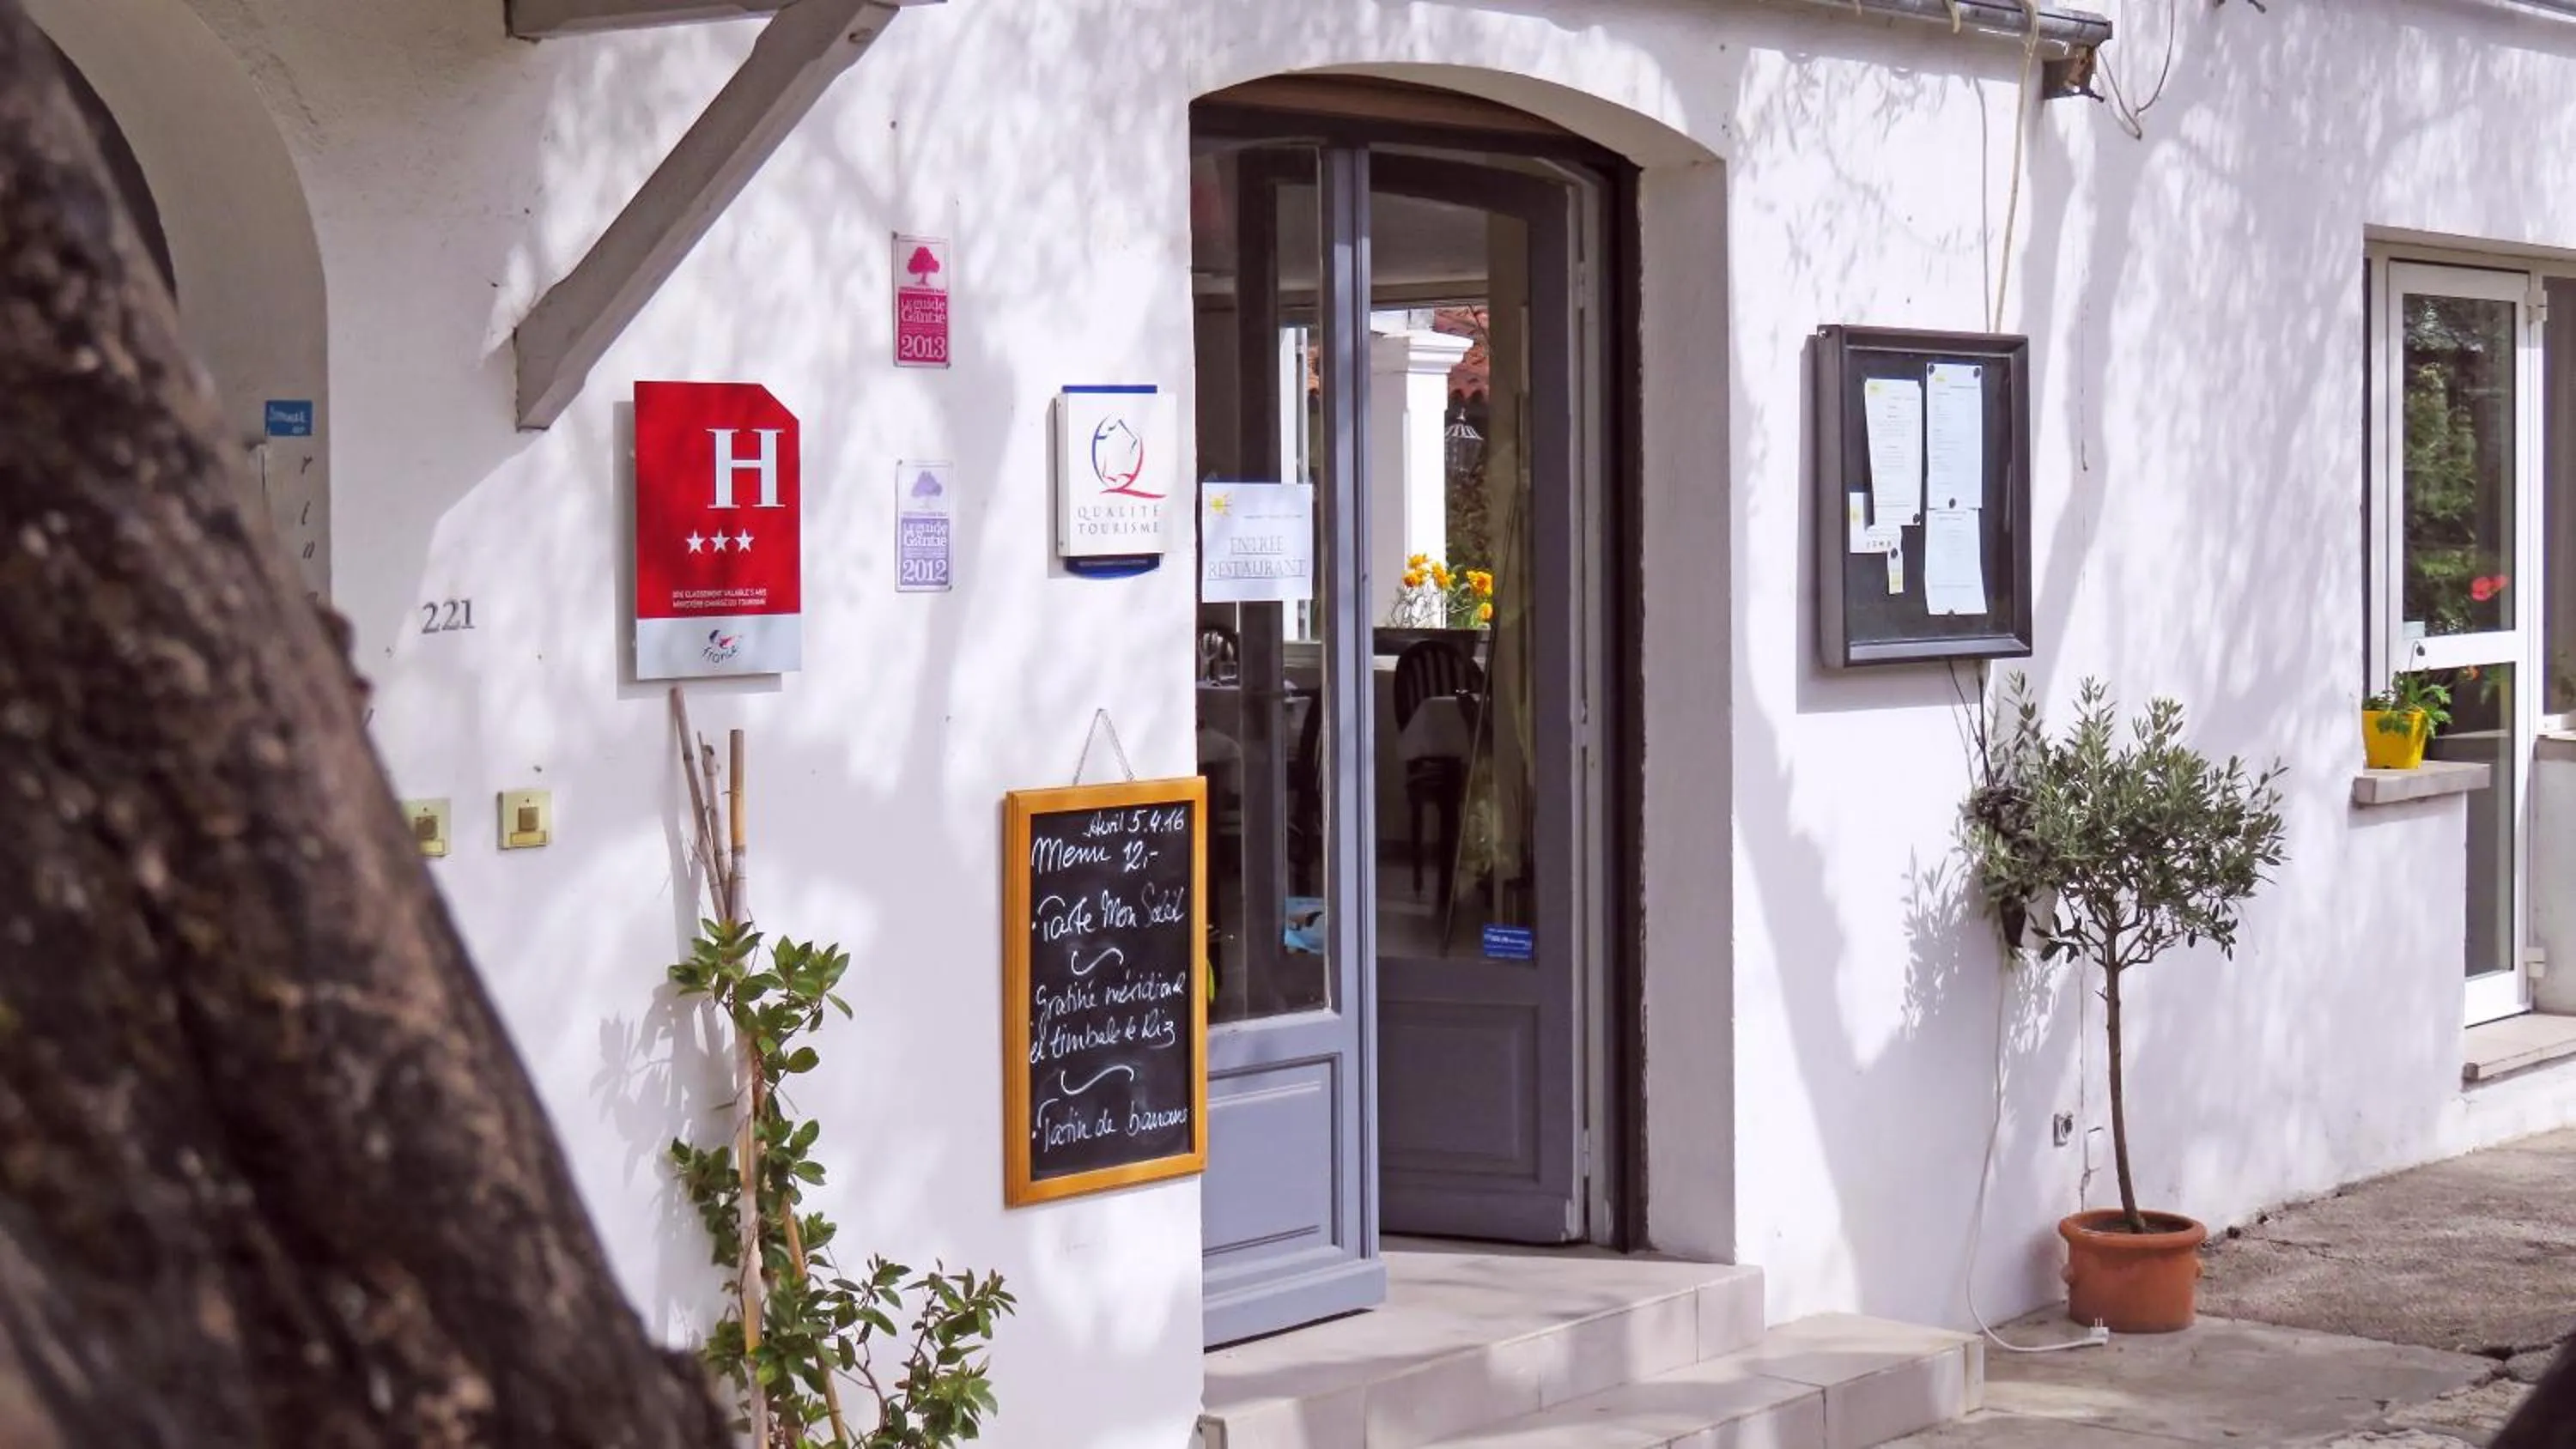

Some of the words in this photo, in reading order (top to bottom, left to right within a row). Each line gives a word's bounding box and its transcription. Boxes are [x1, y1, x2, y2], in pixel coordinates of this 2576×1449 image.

[901, 334, 946, 359] 2013
[704, 427, 787, 509] H
[1078, 521, 1159, 535] TOURISME
[902, 558, 947, 582] 2012
[1206, 559, 1306, 580] RESTAURANT
[421, 598, 476, 634] 221
[1031, 837, 1112, 875] Menu
[1096, 1108, 1116, 1137] de
